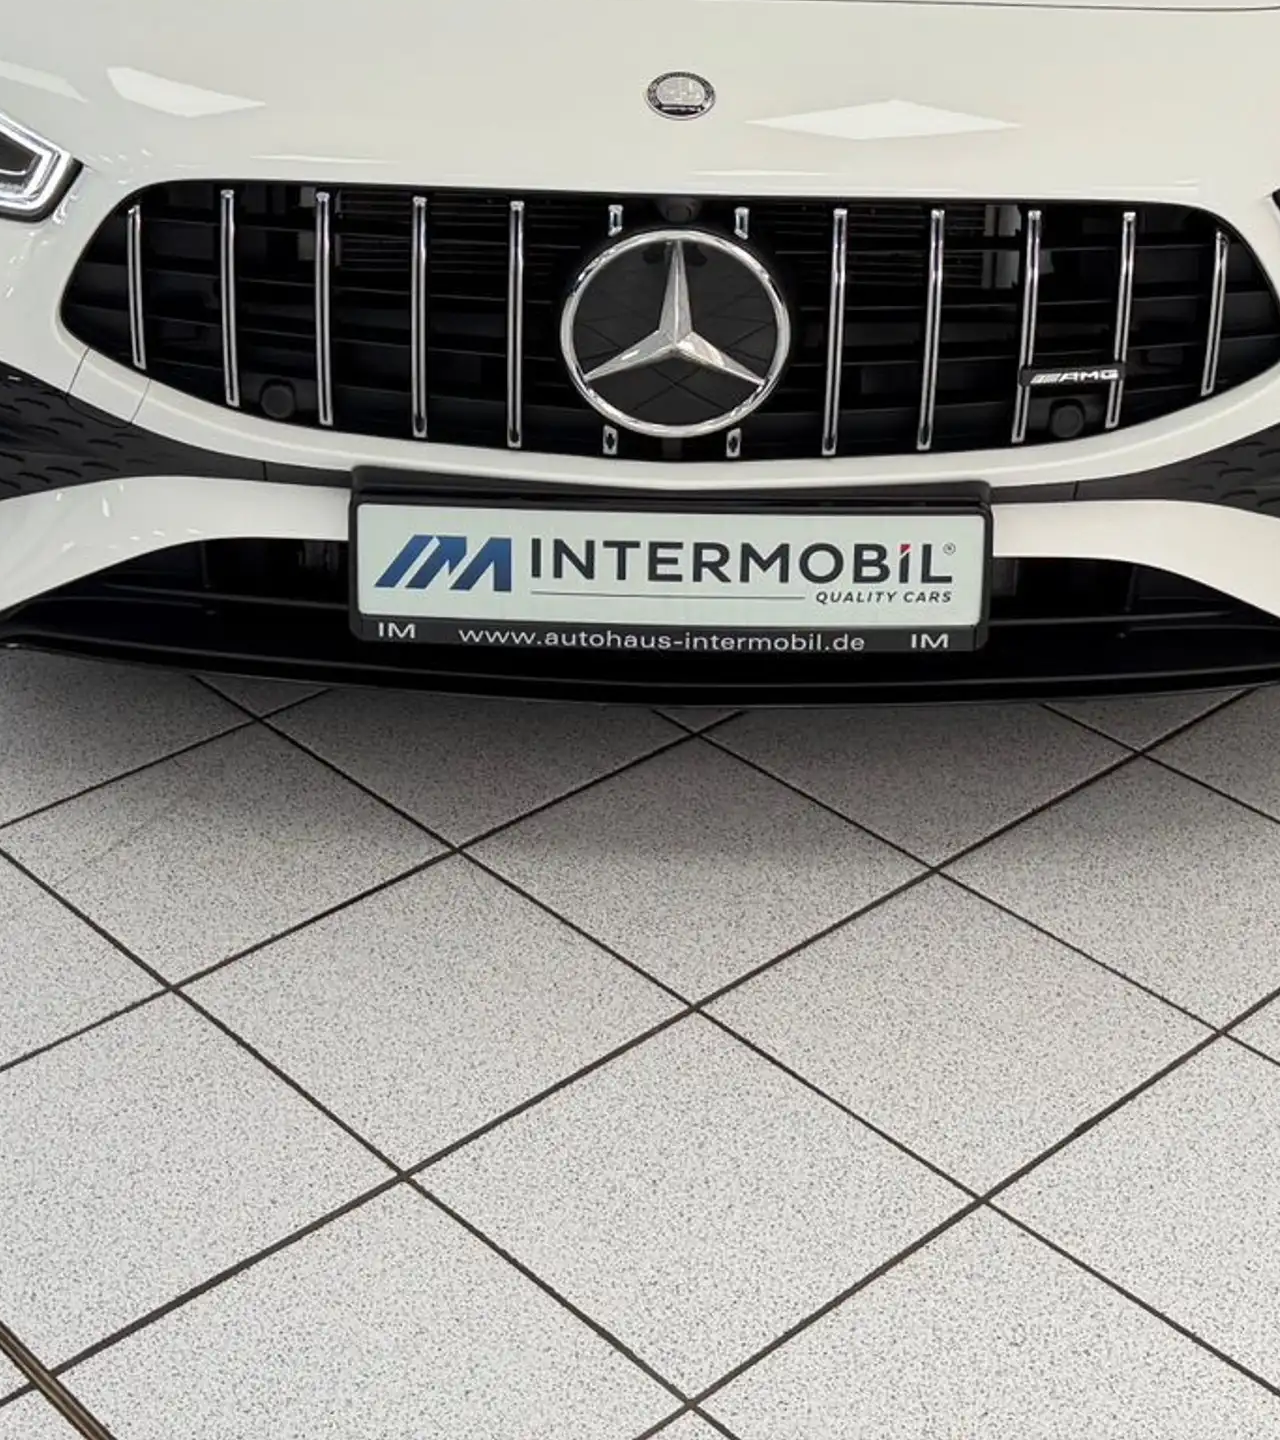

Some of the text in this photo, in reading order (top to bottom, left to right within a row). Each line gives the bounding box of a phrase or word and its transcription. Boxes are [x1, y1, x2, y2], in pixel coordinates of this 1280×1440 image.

[1058, 369, 1119, 383] AMG
[816, 591, 952, 605] QUALITY CARS
[378, 622, 949, 652] IM www.autohaus-intermobil.de IM
